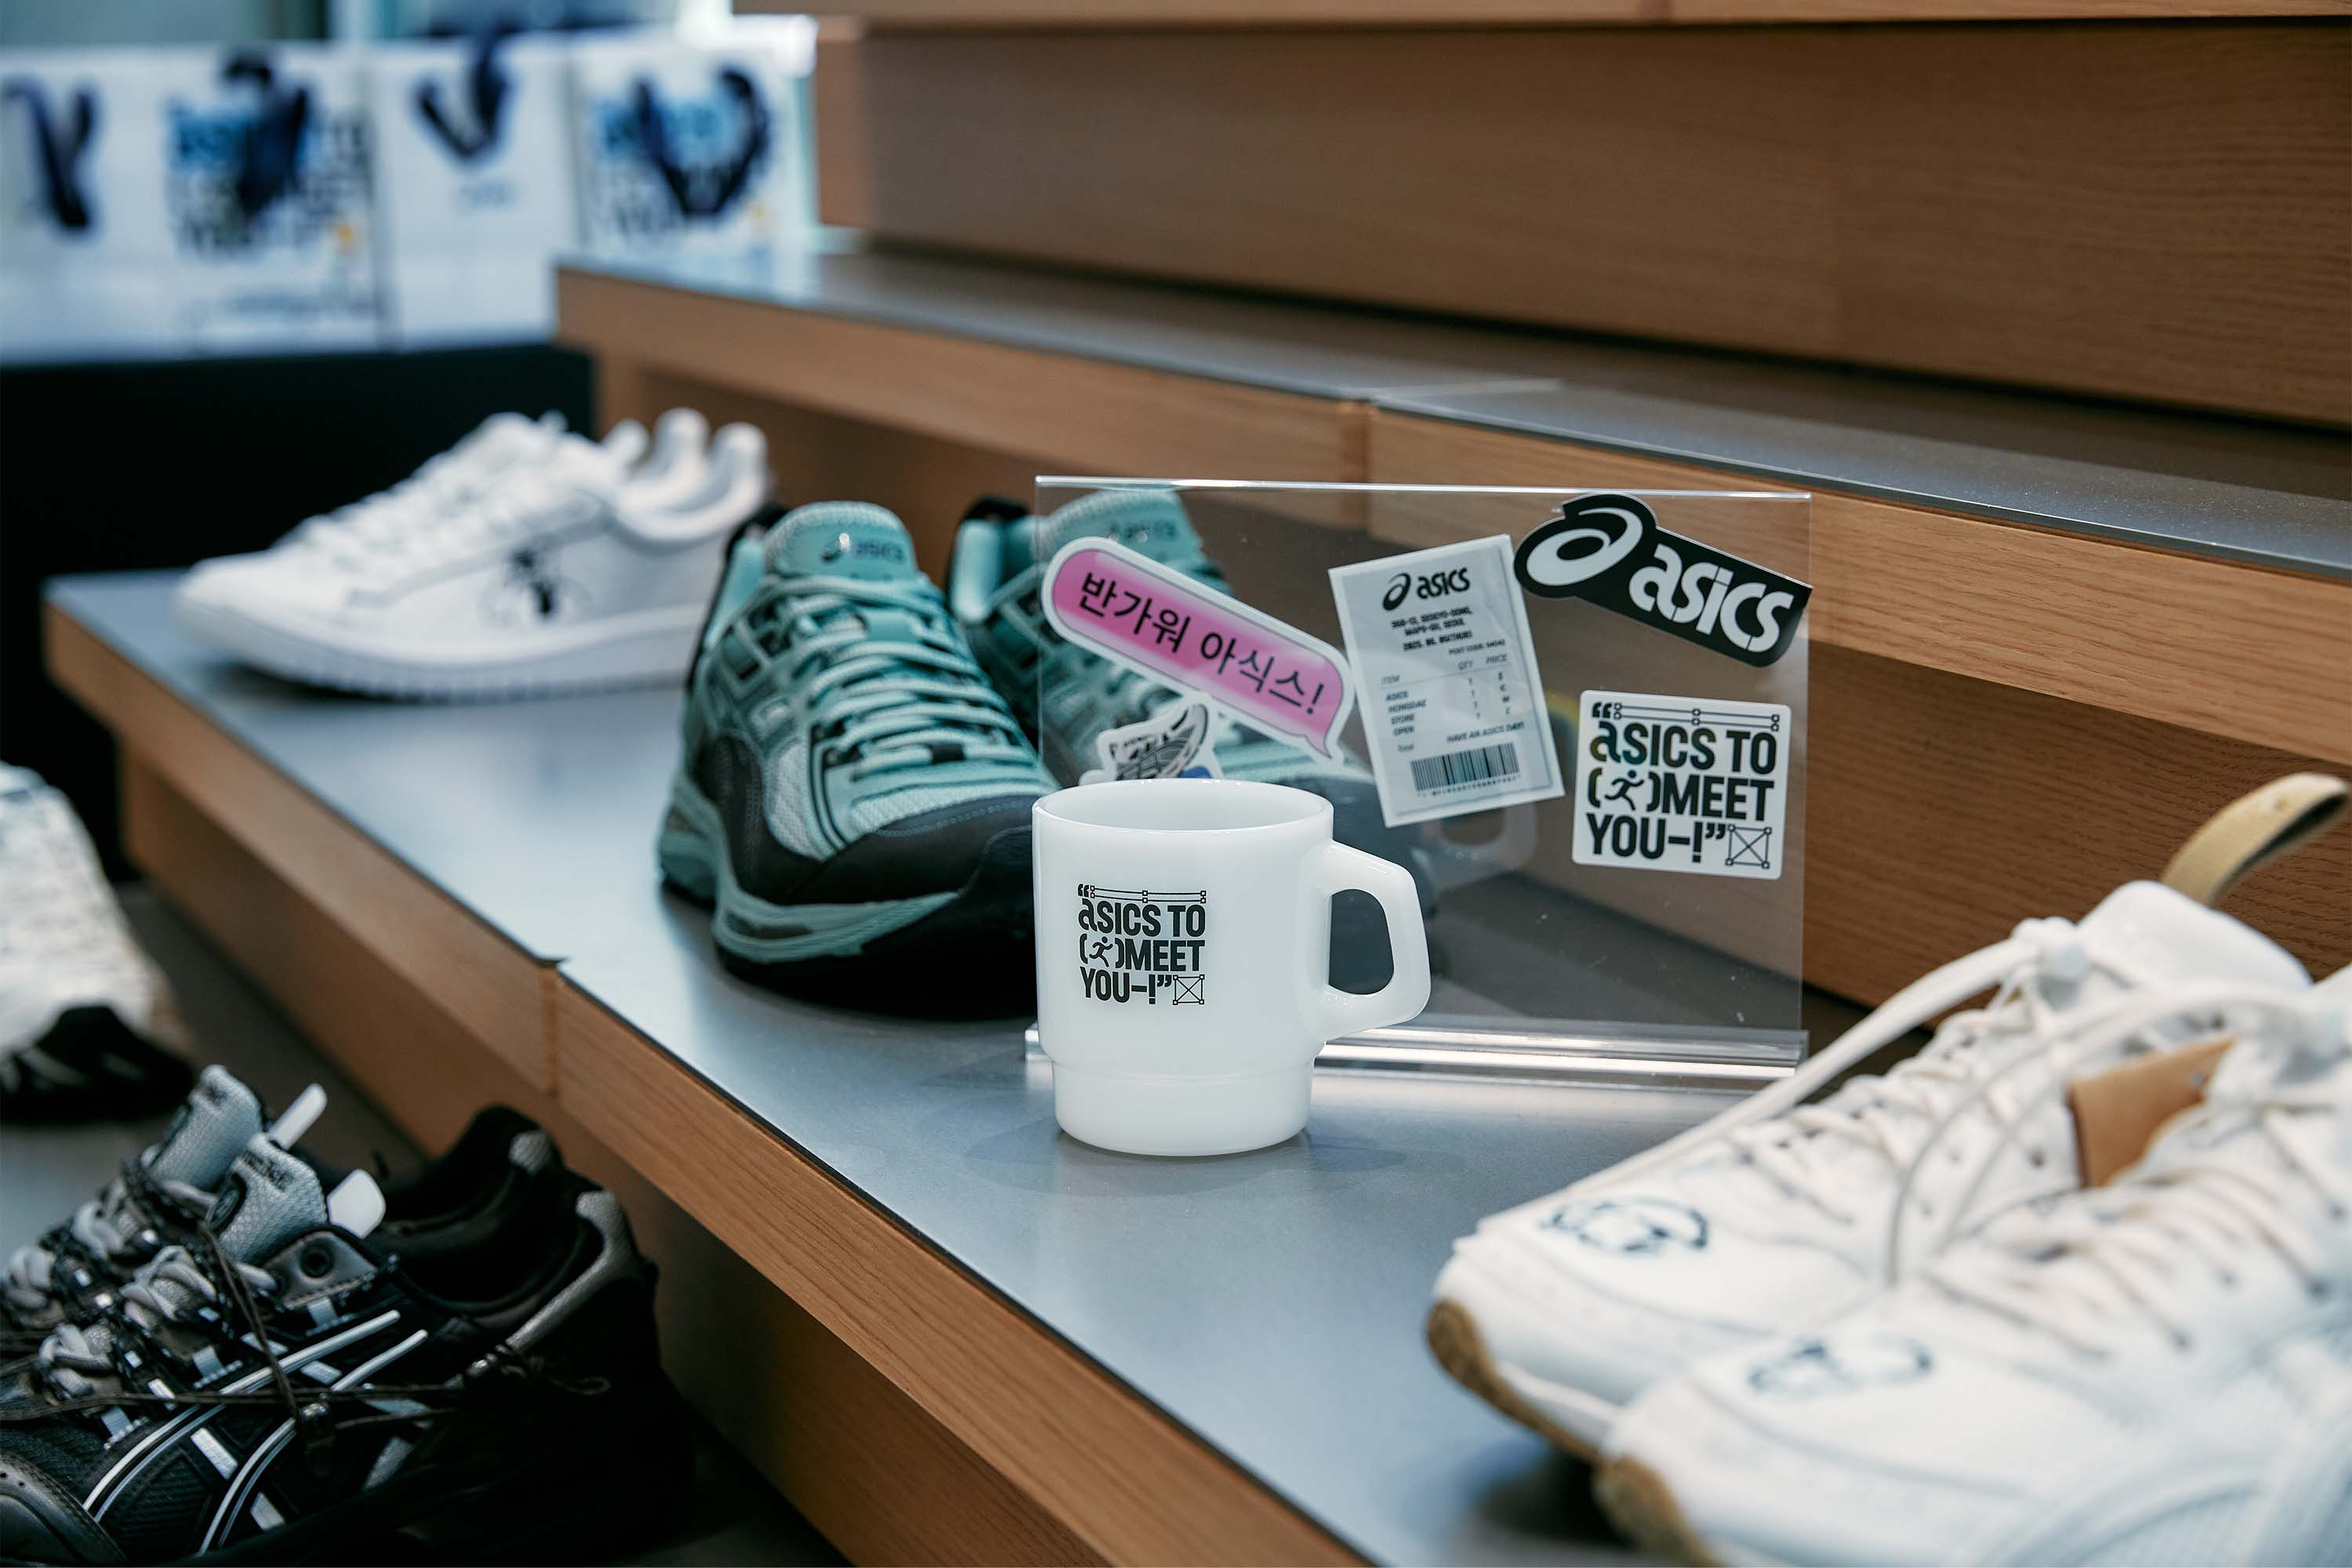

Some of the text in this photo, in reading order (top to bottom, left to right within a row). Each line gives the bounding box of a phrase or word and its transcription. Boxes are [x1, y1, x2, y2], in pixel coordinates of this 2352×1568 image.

[1080, 572, 1325, 714] 반가워 아식스!
[1381, 653, 1507, 684] ITEM QTY PRICE
[1386, 690, 1409, 701] ASICS
[1388, 699, 1426, 713] HONGDAE
[1391, 713, 1414, 724] STORE
[1393, 726, 1414, 735] OPEN
[1447, 732, 1467, 742] HAVE
[1483, 725, 1504, 735] ASICS
[1726, 731, 1777, 775] TO
[1167, 904, 1206, 938] TO
